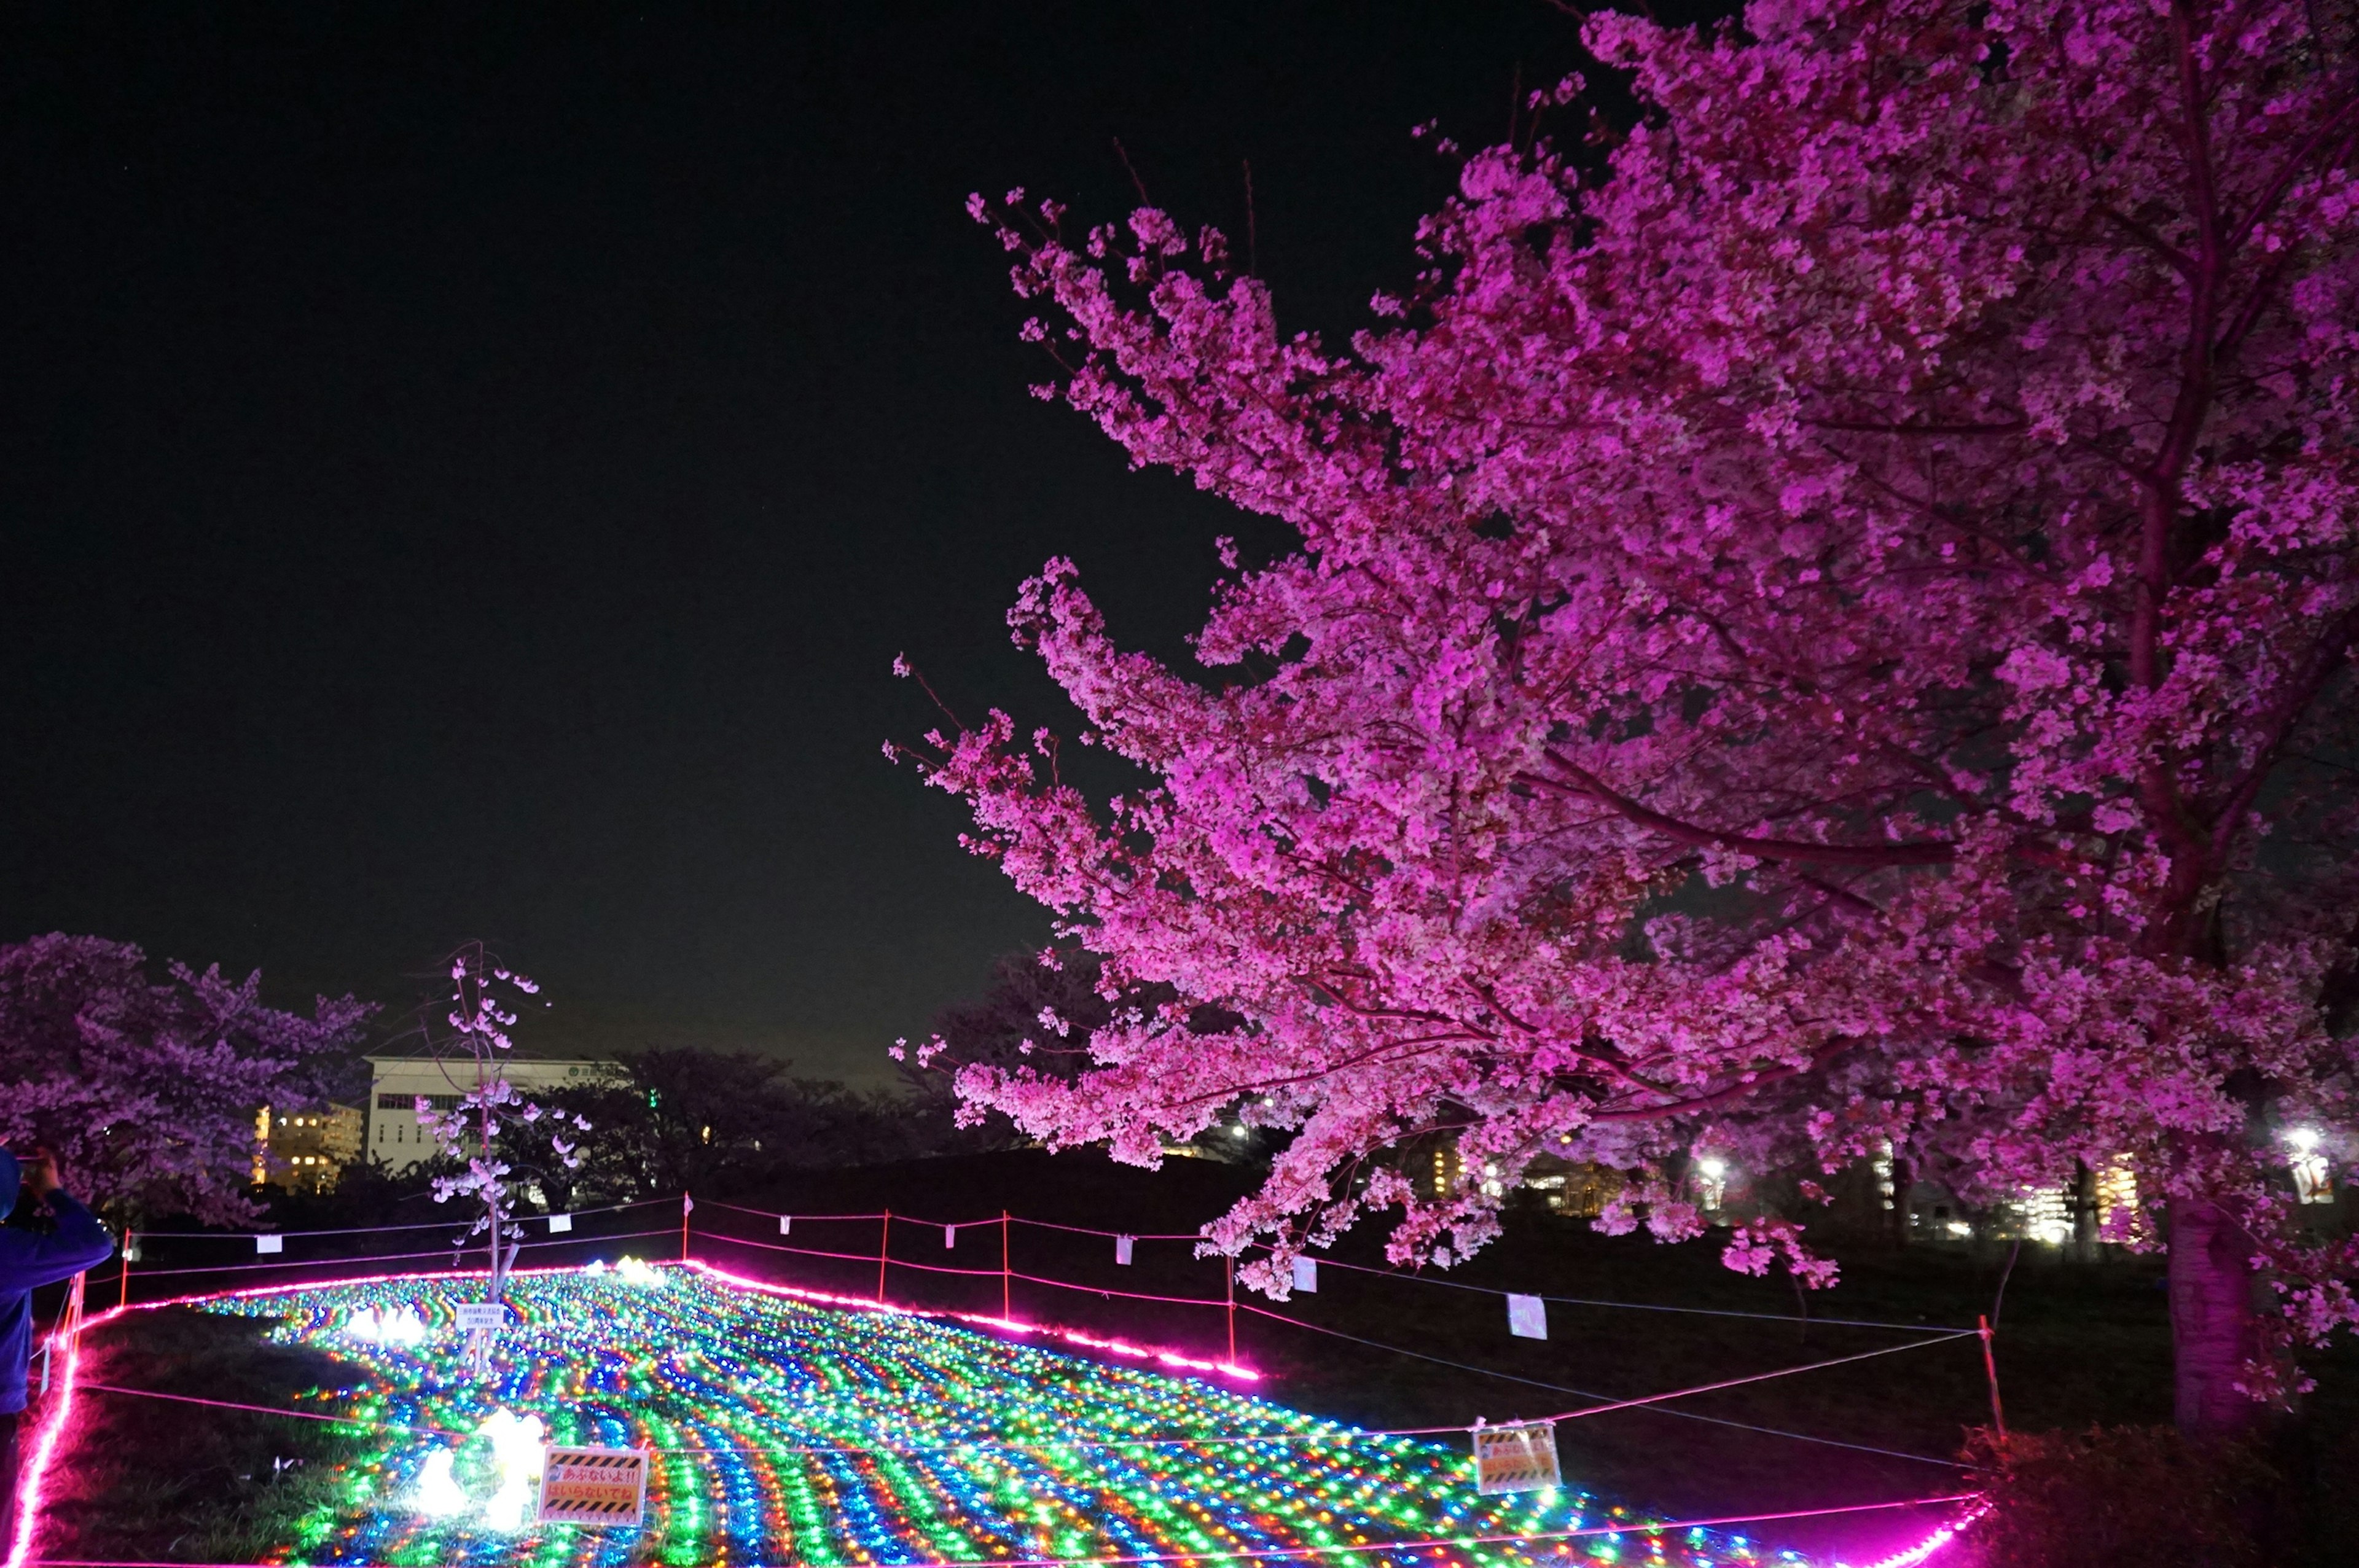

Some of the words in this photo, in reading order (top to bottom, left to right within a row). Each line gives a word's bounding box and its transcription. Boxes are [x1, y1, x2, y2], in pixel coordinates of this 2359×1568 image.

[548, 1485, 633, 1500] はいらないでね
